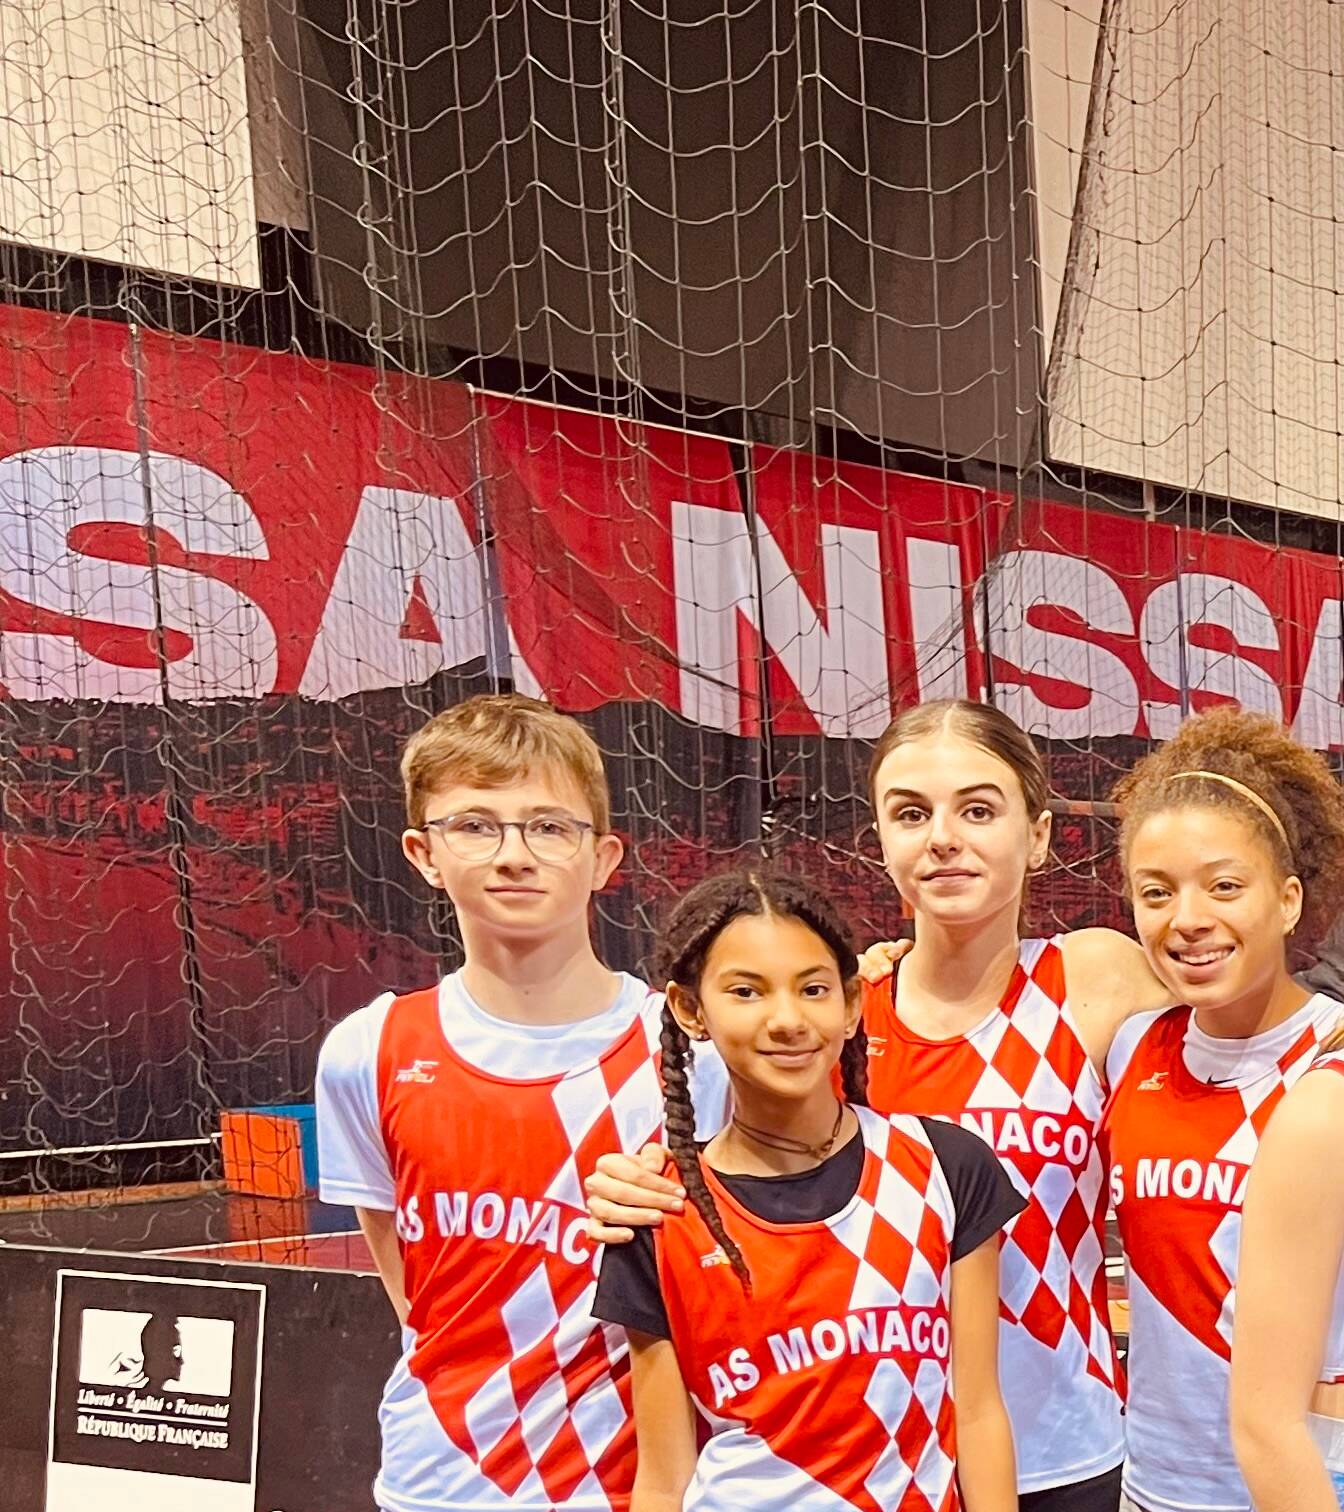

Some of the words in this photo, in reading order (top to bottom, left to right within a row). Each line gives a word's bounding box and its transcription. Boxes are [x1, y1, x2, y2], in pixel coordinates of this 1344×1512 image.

[958, 1111, 1089, 1165] NACO
[1110, 1164, 1125, 1206] S
[434, 1191, 605, 1278] MONAC
[707, 1347, 760, 1408] AS
[767, 1307, 949, 1376] MONACO
